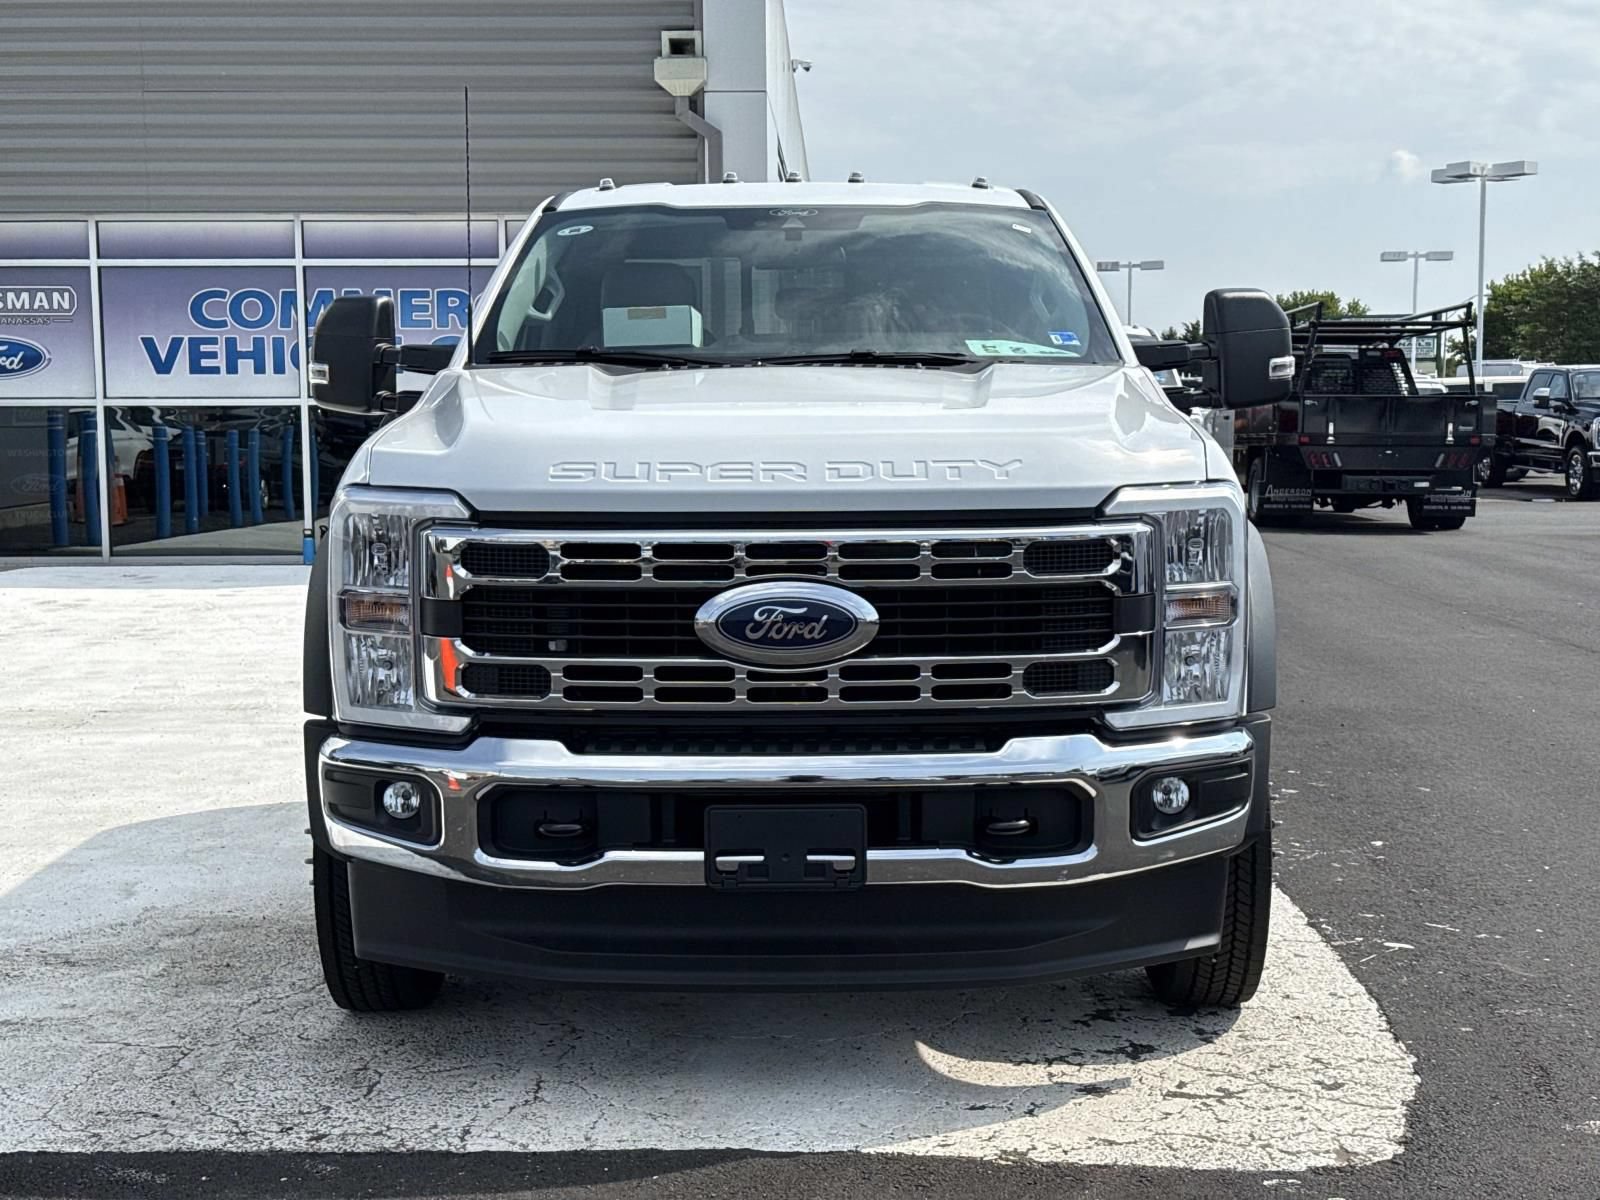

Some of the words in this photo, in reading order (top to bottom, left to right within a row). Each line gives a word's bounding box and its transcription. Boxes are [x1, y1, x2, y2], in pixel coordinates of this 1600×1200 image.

[0, 291, 70, 310] MAN
[187, 288, 483, 331] COMER
[547, 461, 808, 483] SUPER
[825, 459, 1023, 482] DUTY
[745, 605, 829, 640] Ford
